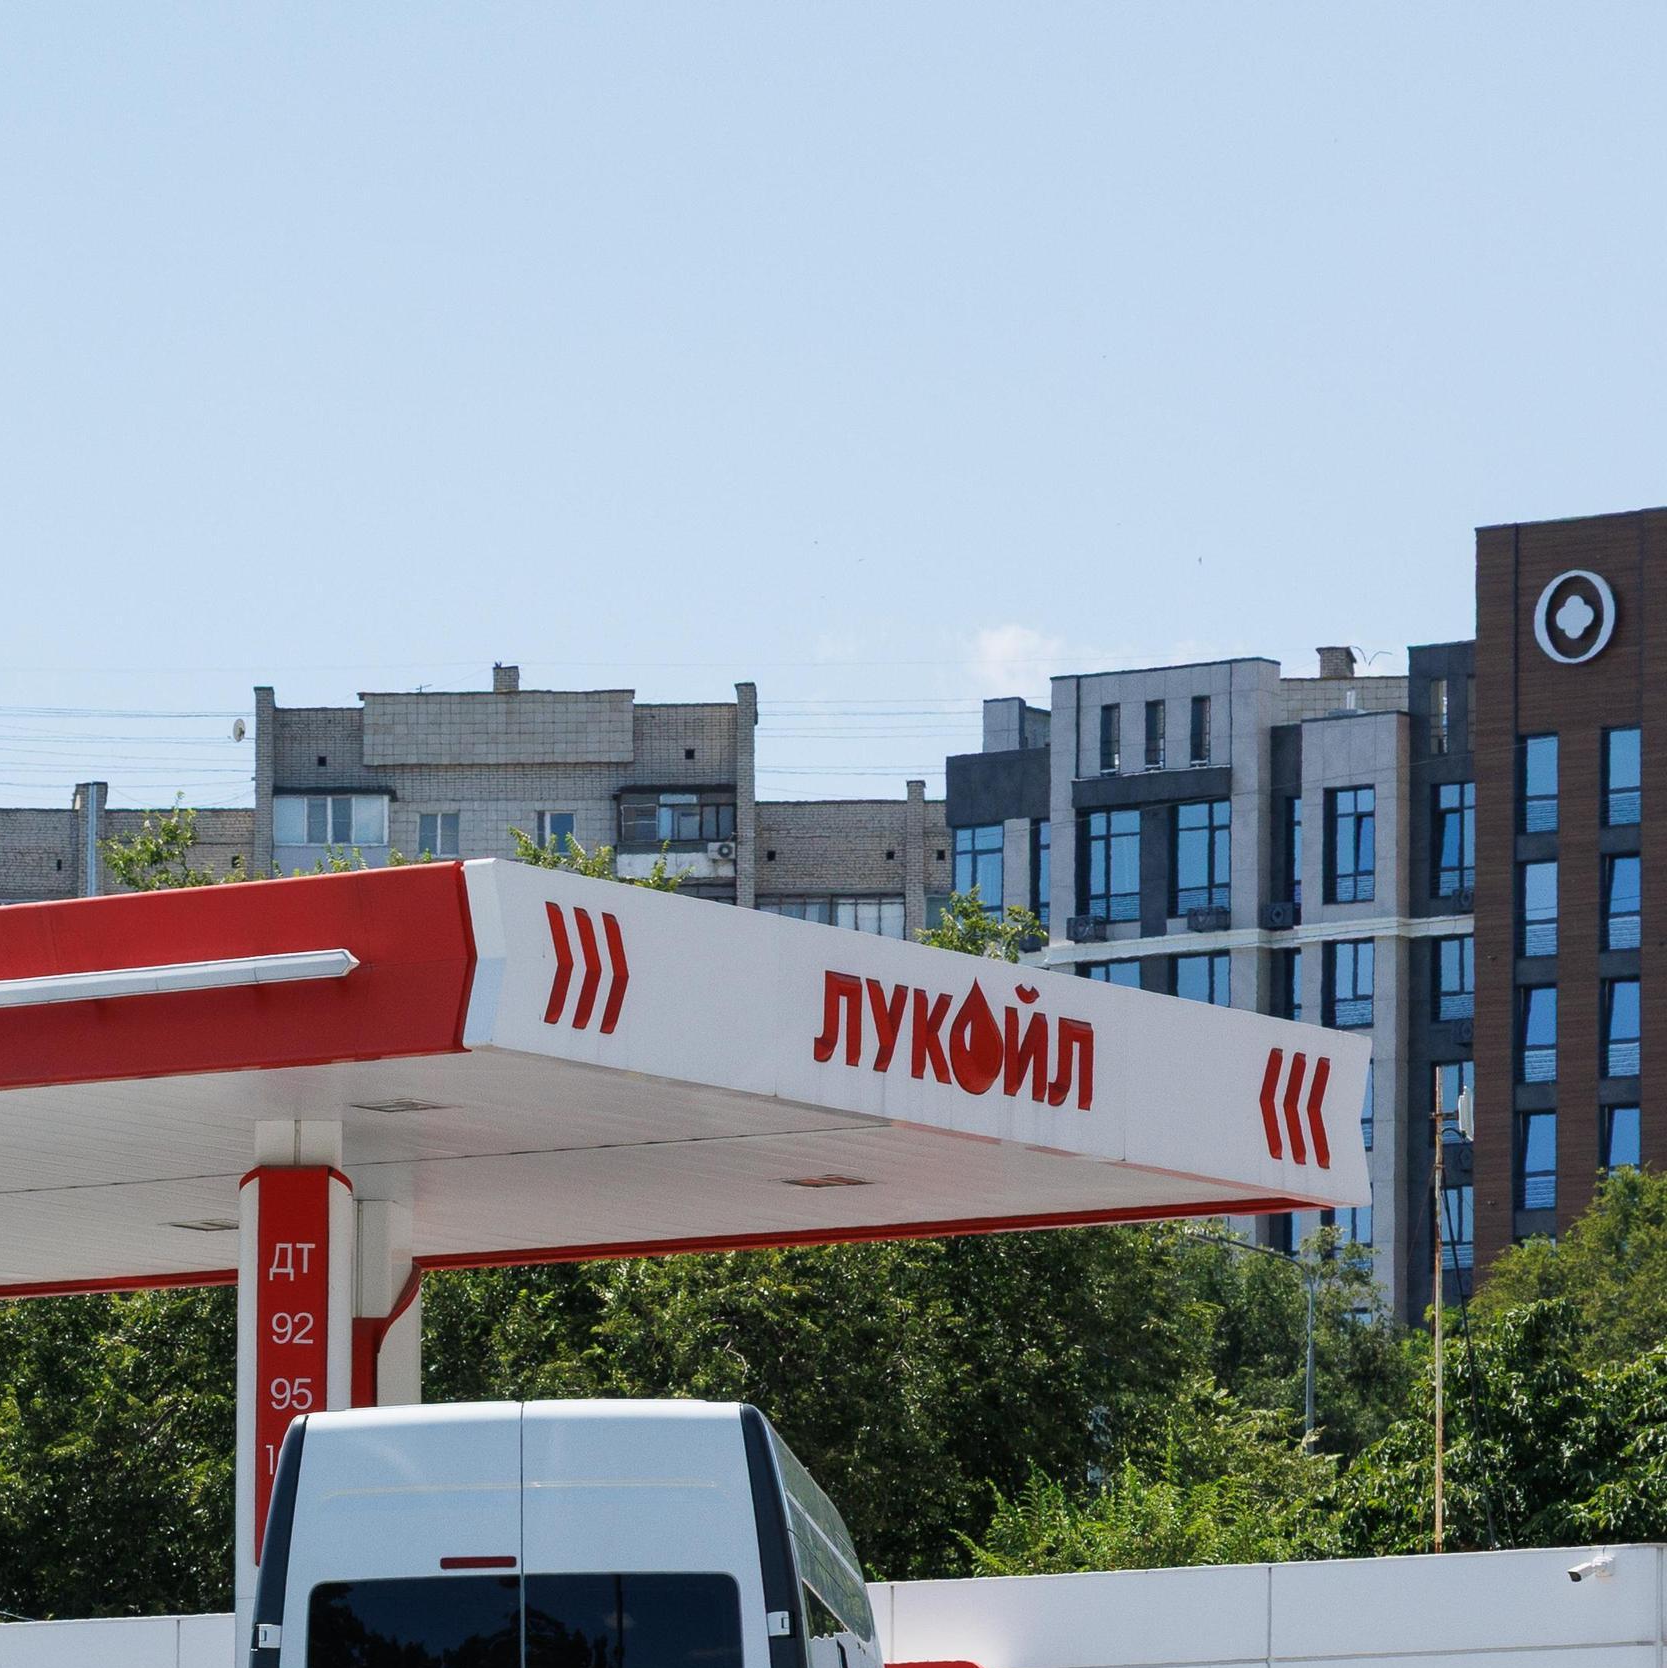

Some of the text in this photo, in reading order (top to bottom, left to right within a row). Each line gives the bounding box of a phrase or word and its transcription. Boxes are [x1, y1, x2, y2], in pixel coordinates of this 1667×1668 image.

[814, 970, 1094, 1111] ЛУКОЙЛ
[269, 1243, 316, 1281] ДТ
[272, 1312, 314, 1344] 92
[270, 1377, 313, 1410] 95
